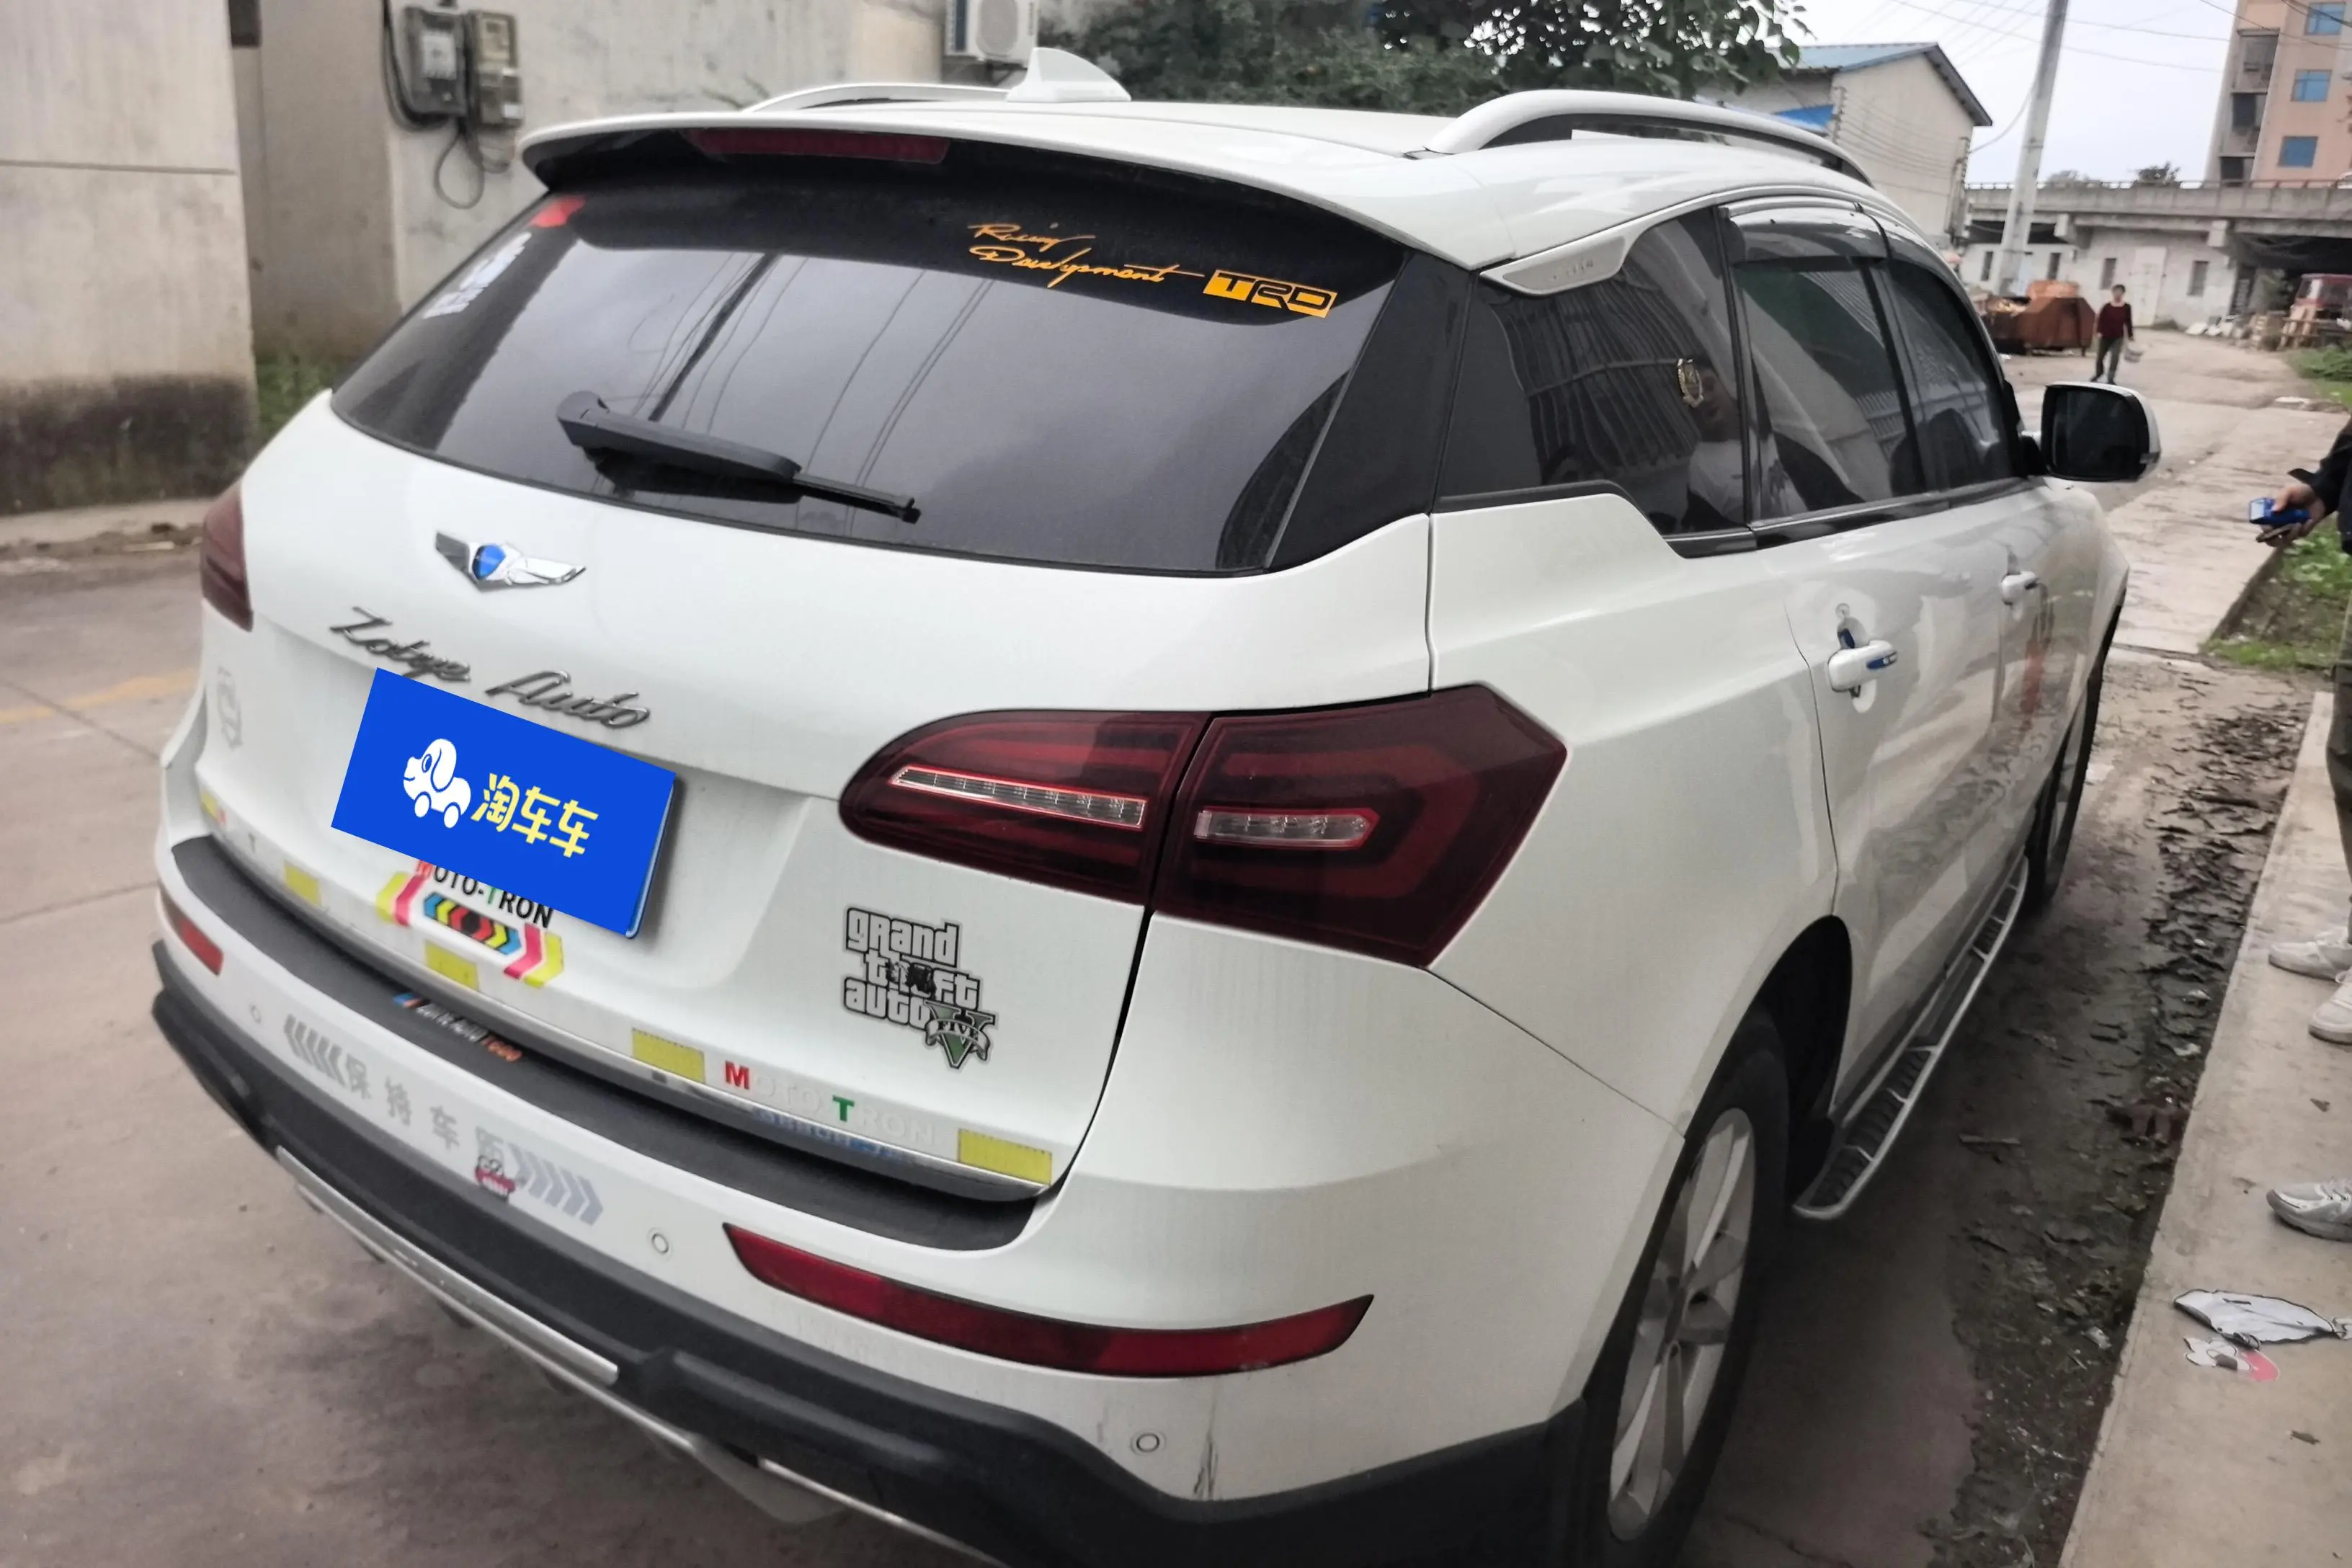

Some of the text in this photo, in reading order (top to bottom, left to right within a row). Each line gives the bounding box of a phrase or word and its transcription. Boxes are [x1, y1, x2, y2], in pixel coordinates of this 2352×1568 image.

[1217, 271, 1332, 311] TRD
[329, 606, 651, 729] Zotye Auto
[844, 976, 931, 1031] auto
[864, 949, 980, 1012] tft
[937, 1019, 981, 1042] FIVE
